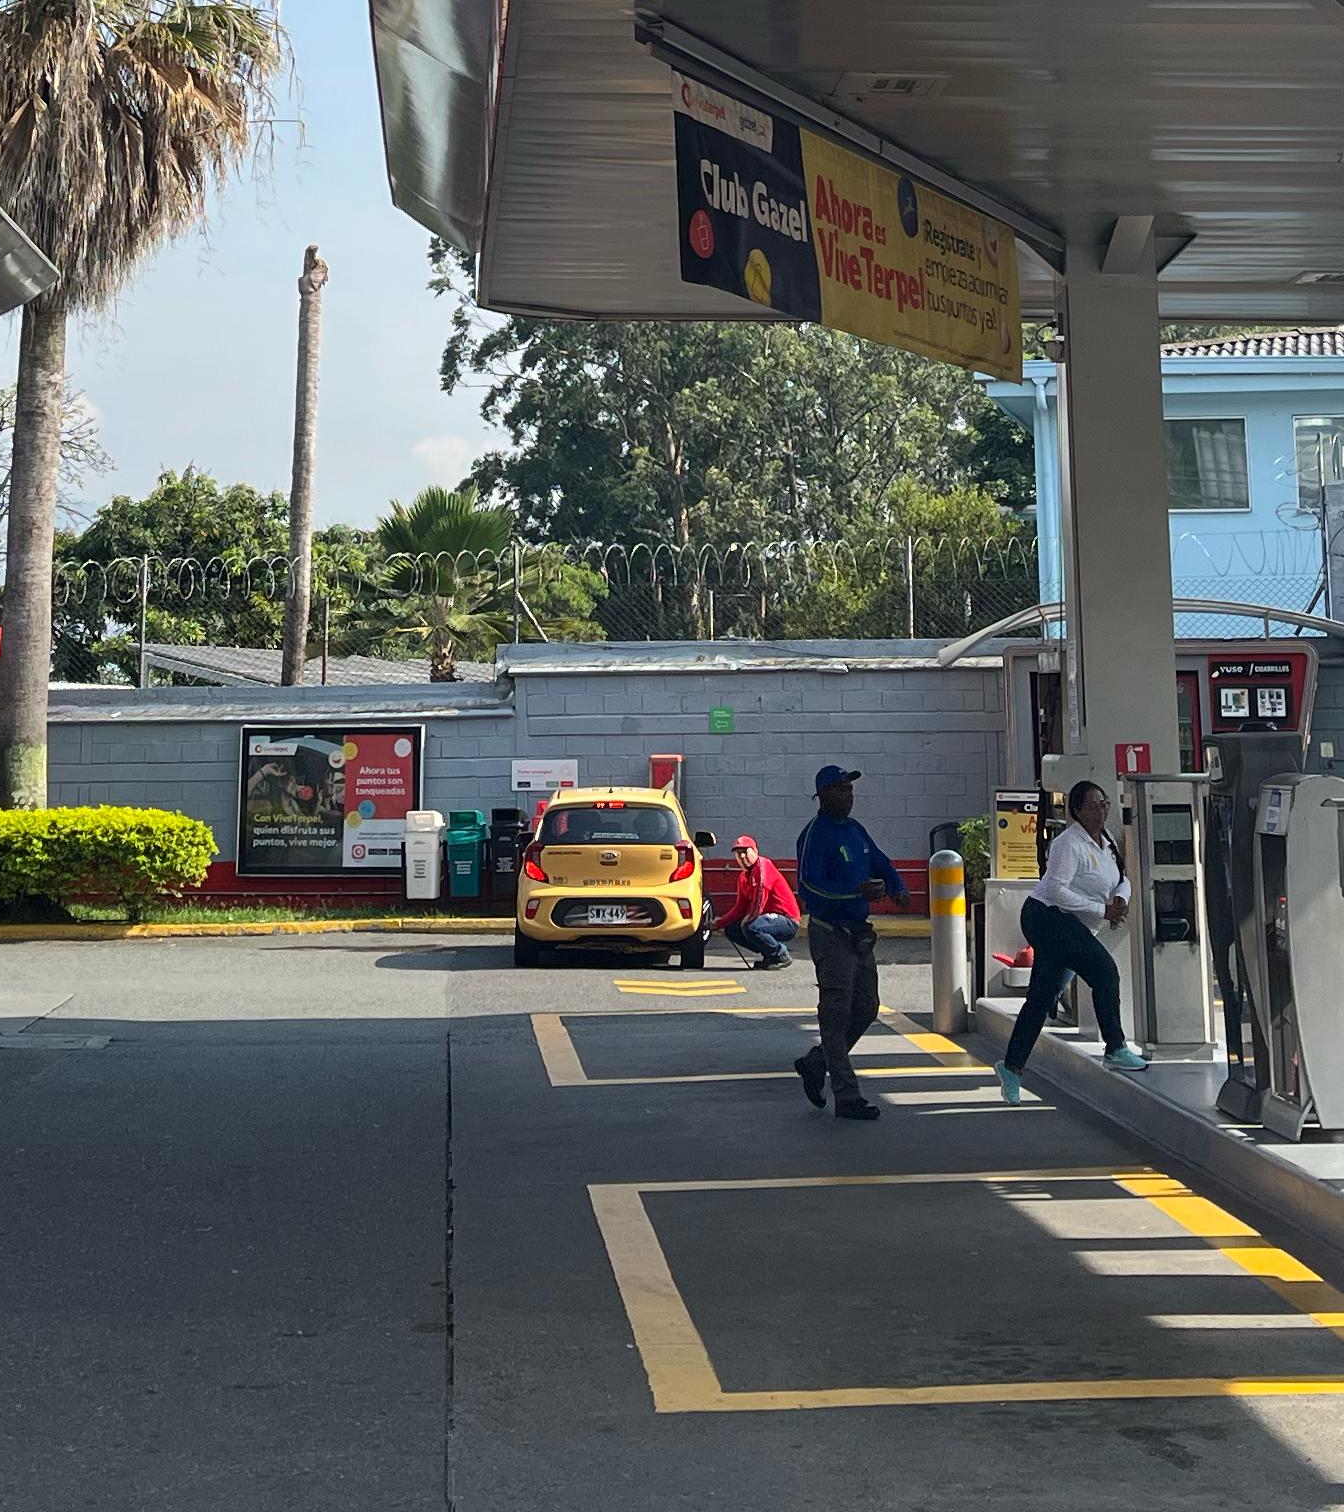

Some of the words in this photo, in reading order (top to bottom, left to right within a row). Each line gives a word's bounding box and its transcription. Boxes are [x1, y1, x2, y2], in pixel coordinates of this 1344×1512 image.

[700, 159, 749, 219] Club
[753, 181, 808, 243] Gazel
[816, 174, 874, 242] Ahora
[359, 766, 385, 775] Ahora
[387, 766, 400, 775] tus
[356, 777, 386, 786] puntos
[356, 787, 405, 796] tanqueadas
[253, 814, 271, 823] Con
[253, 826, 279, 836] quien
[280, 825, 317, 835] disfruta
[319, 827, 335, 835] sus
[252, 838, 287, 848] puntos,
[288, 838, 308, 847] vive
